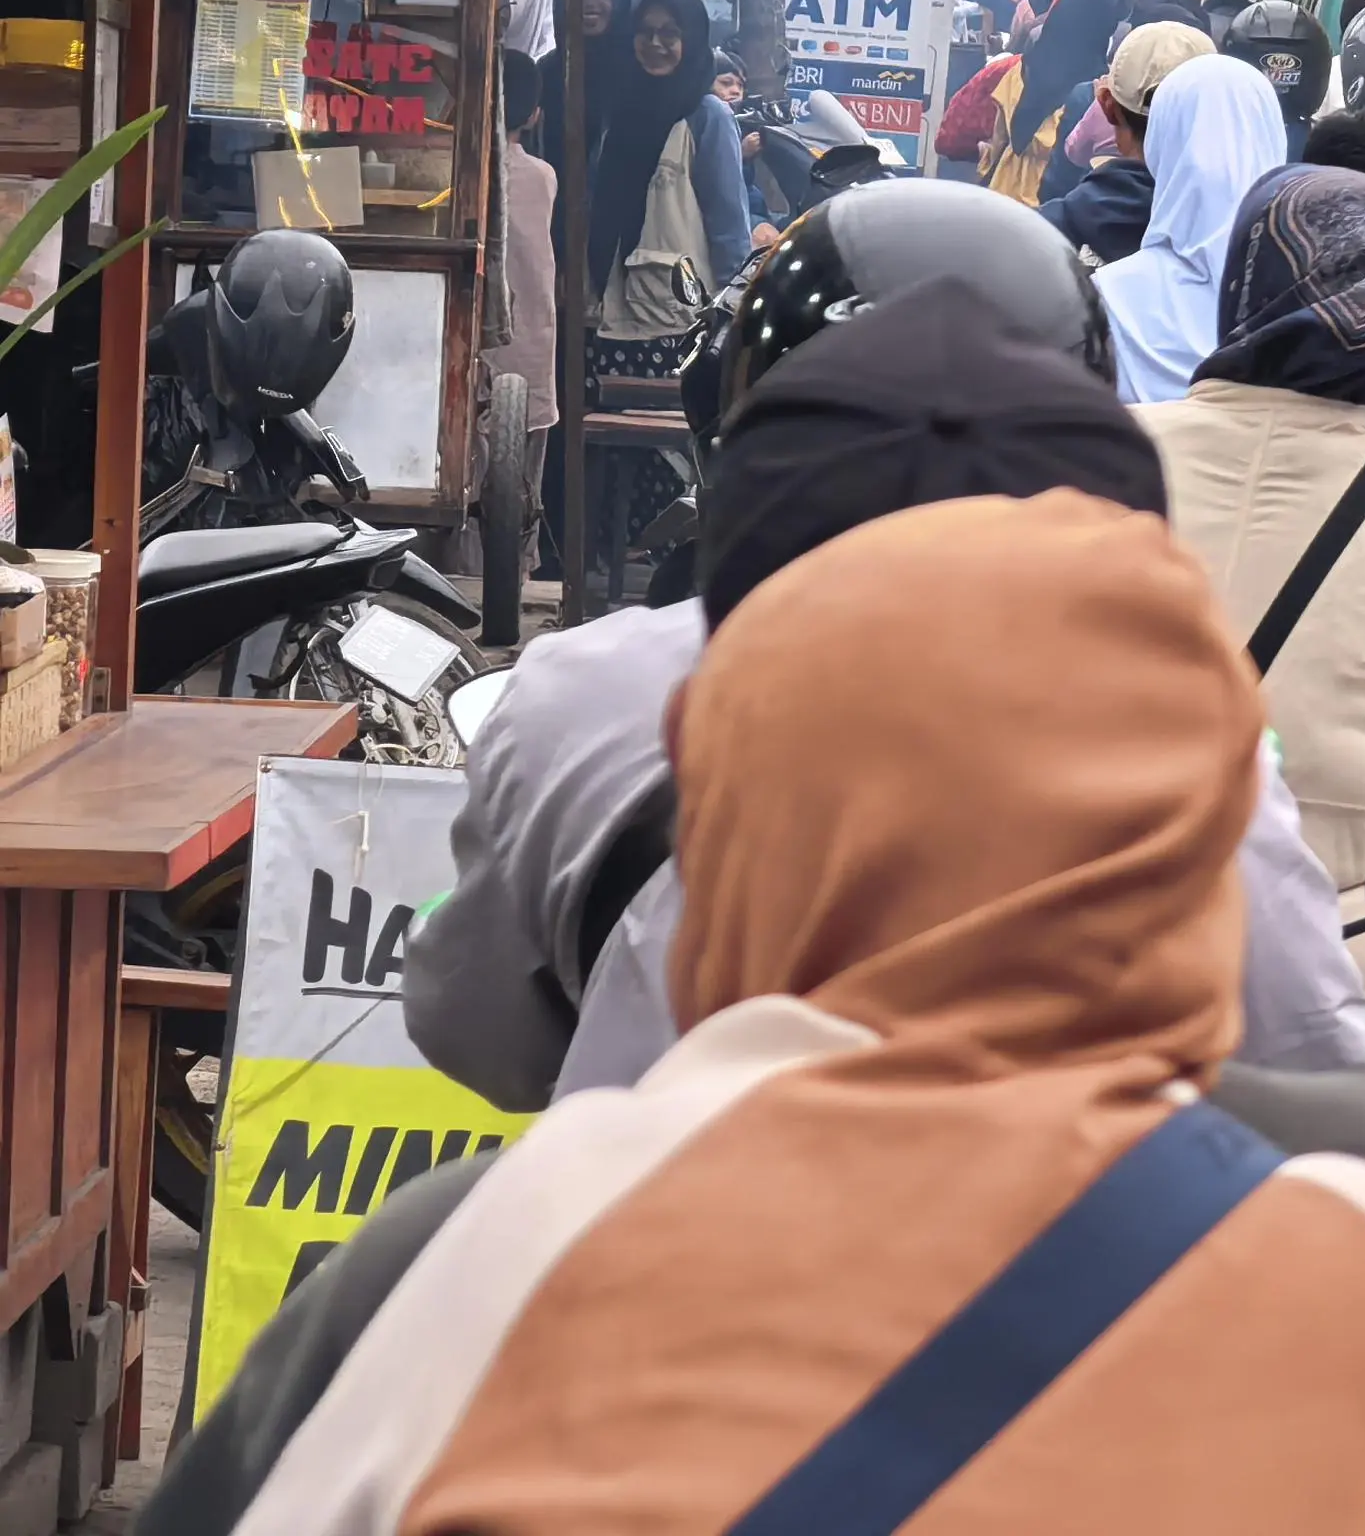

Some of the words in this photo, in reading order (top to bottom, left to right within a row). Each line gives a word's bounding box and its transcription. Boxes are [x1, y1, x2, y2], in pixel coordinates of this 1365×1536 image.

[302, 39, 433, 83] SATE
[793, 66, 824, 85] BRI
[302, 92, 426, 135] AYAM
[871, 101, 911, 126] BNI
